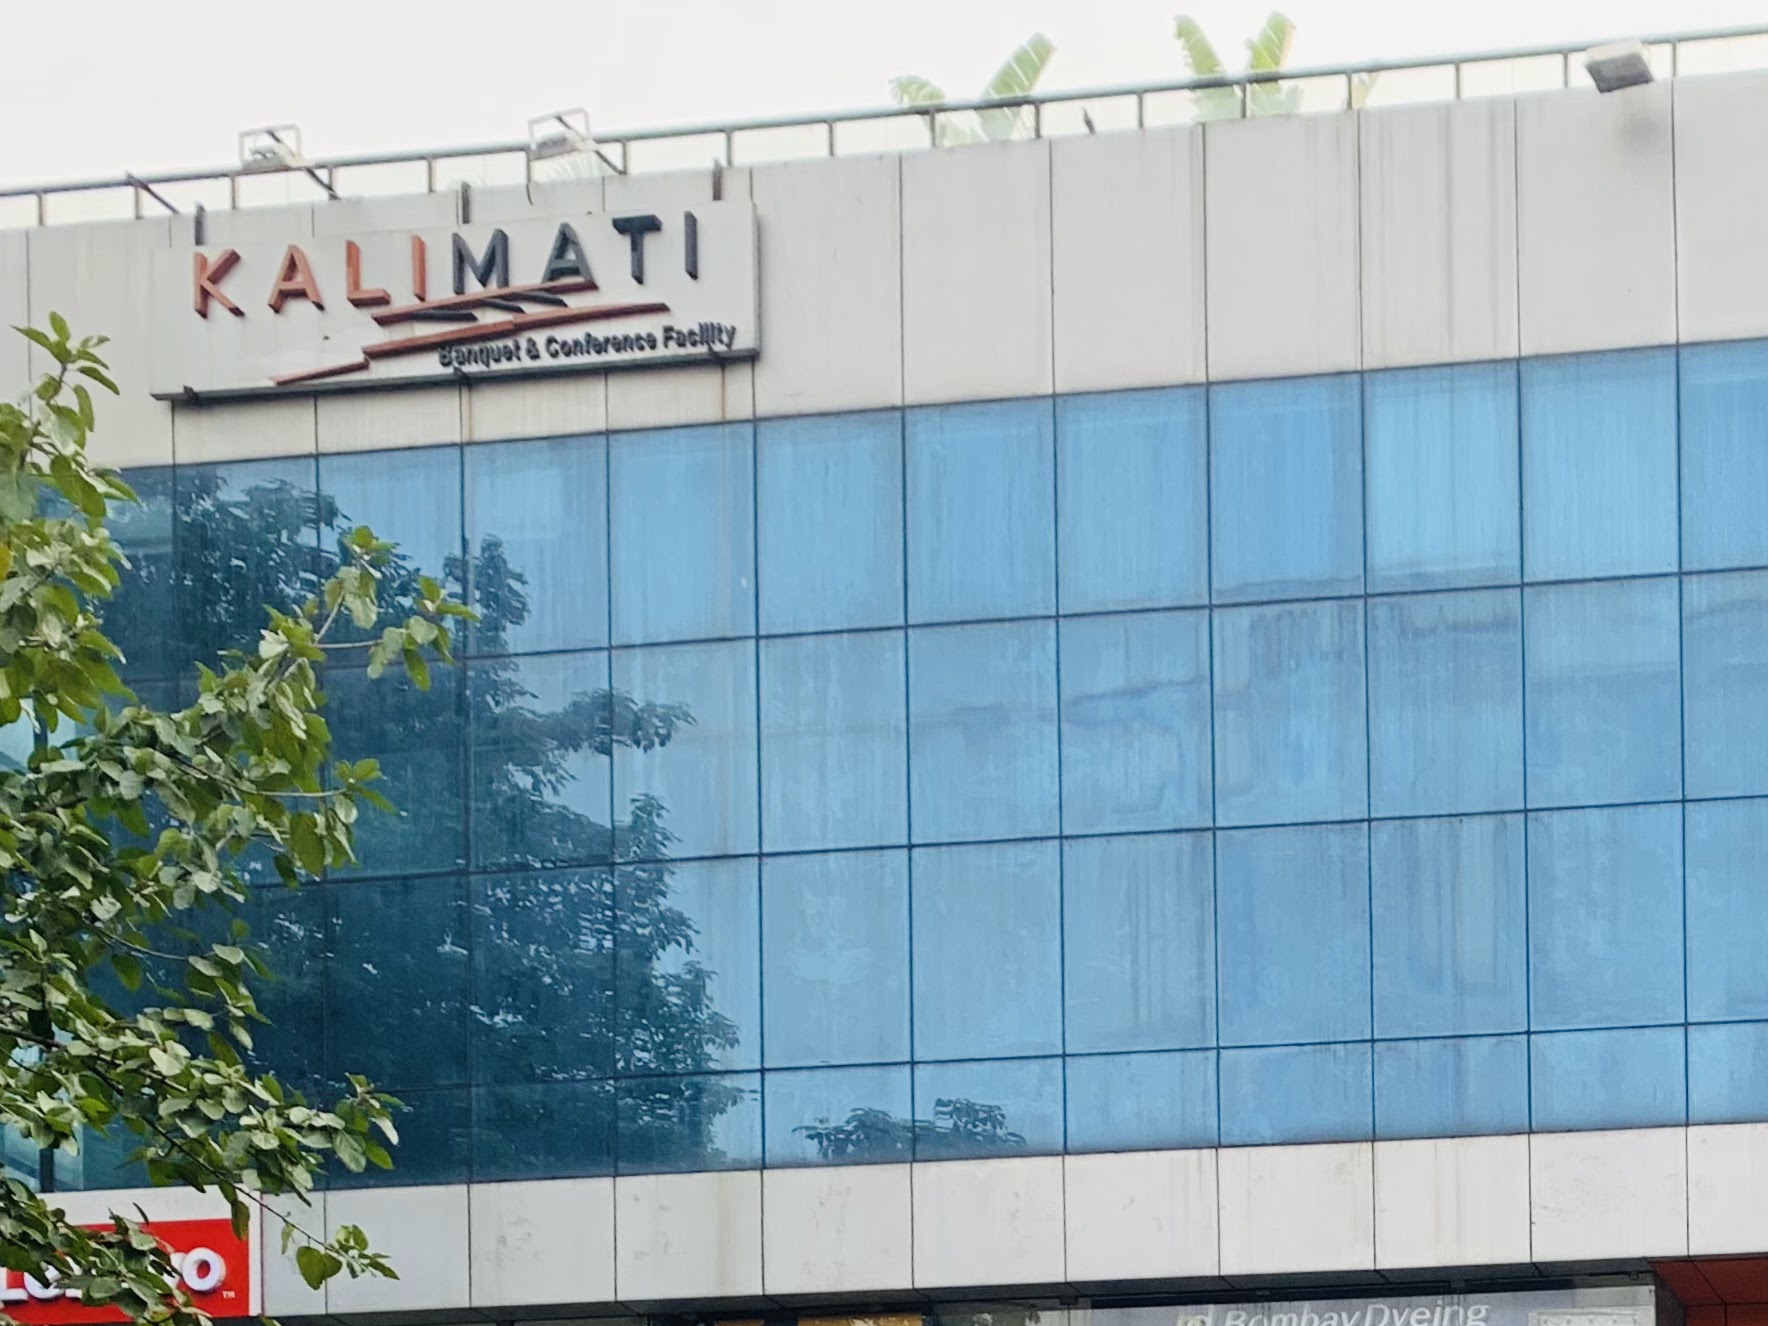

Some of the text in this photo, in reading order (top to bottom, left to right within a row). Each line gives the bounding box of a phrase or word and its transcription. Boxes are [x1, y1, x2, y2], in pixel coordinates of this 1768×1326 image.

[192, 210, 699, 319] KALIMATI
[438, 322, 737, 369] Banquet & Conference Facility
